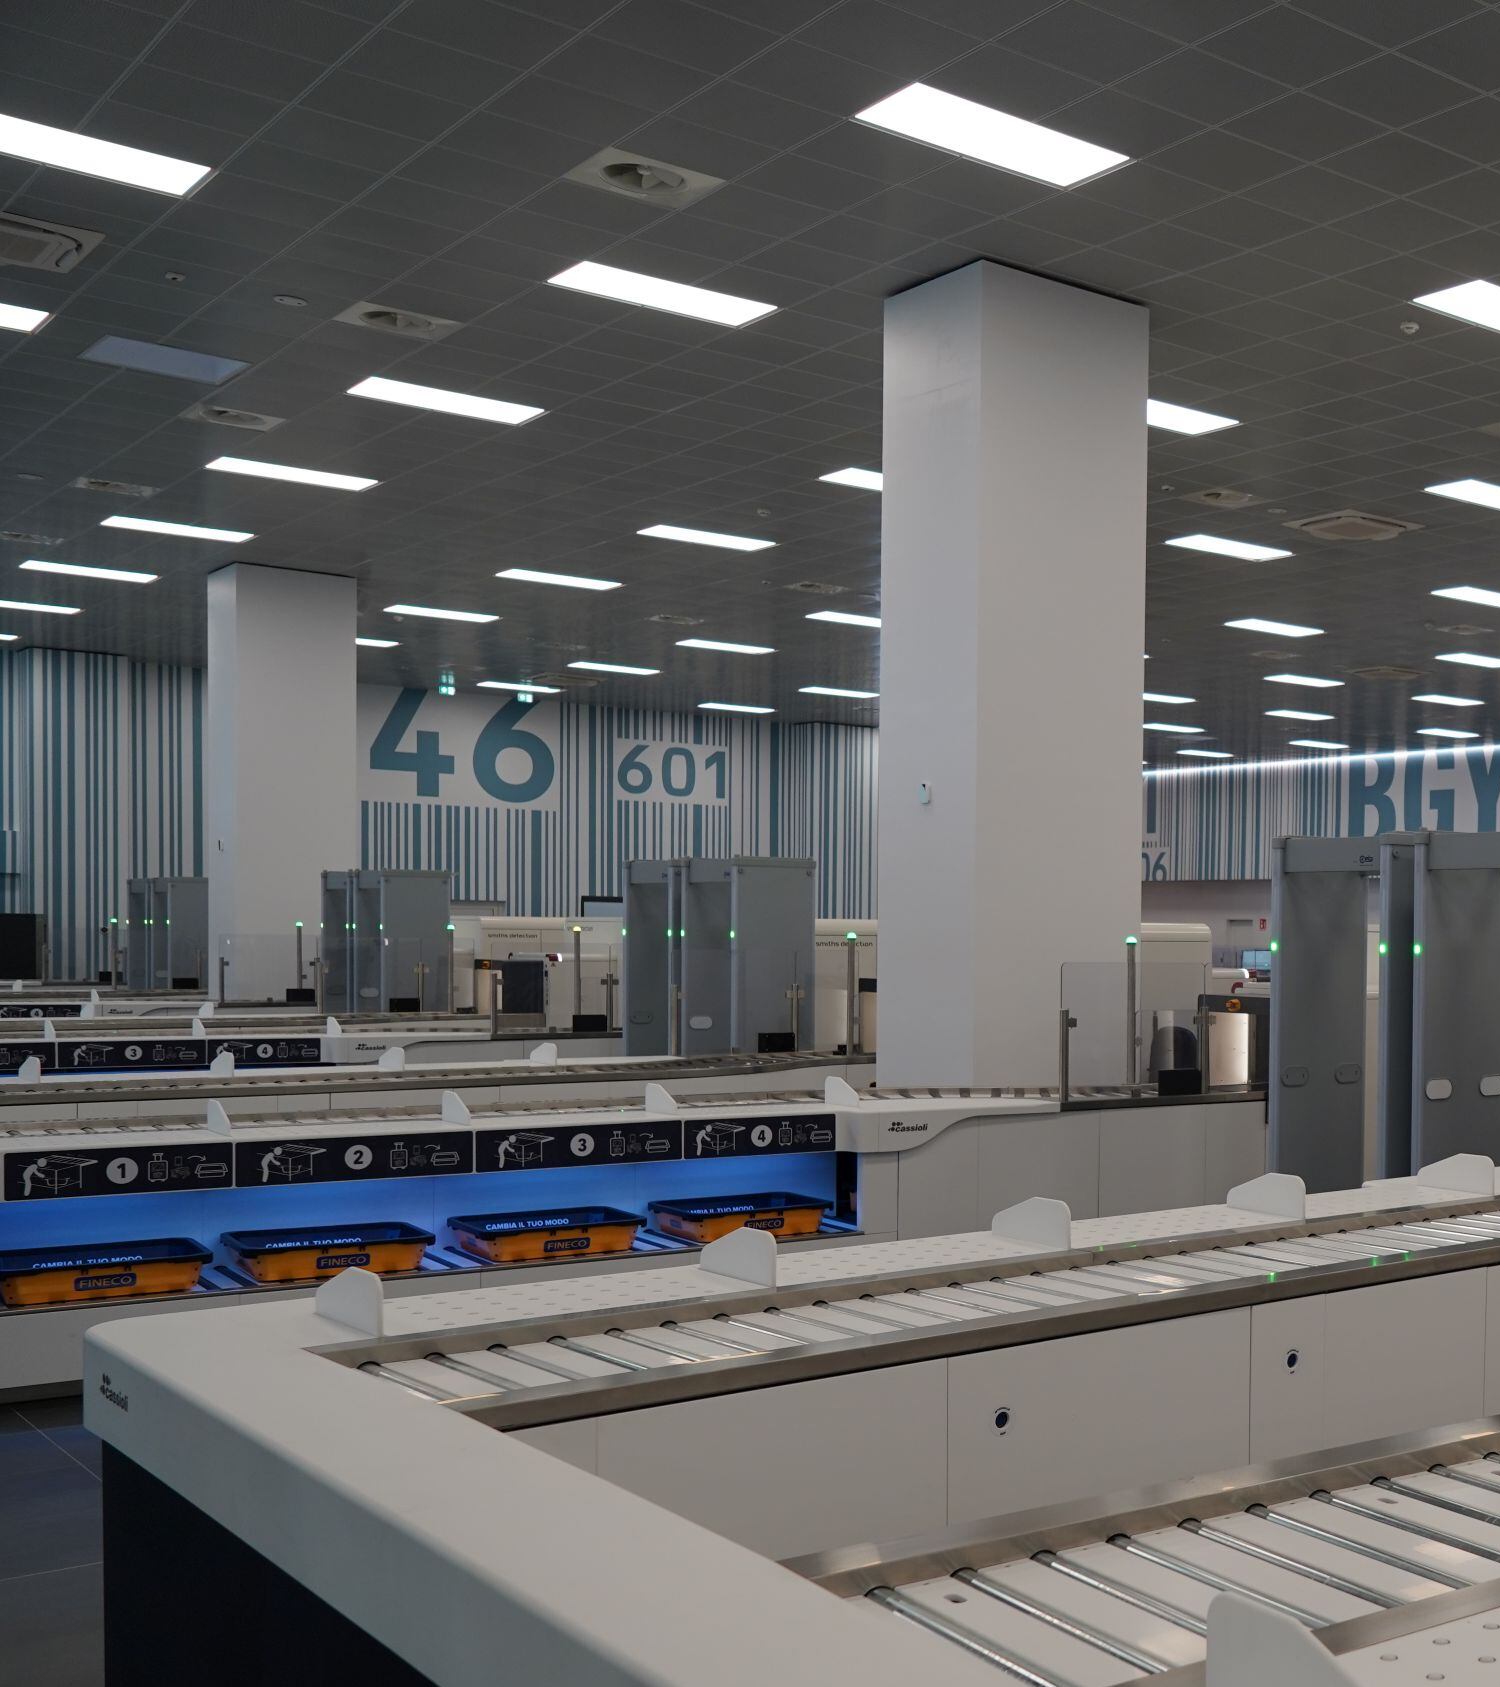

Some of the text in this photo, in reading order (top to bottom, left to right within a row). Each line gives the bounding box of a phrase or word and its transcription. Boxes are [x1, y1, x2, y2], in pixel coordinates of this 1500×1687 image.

[370, 687, 555, 803] 46
[617, 744, 726, 799] 601
[130, 1049, 137, 1058] 3
[260, 1047, 269, 1056] 4
[757, 1129, 766, 1142] 4
[577, 1138, 588, 1152] 3
[353, 1150, 364, 1165] 2
[116, 1163, 126, 1179] 1
[485, 1217, 570, 1231] CAMBIA IL TUO MODO
[747, 1219, 783, 1230] FINECO
[547, 1238, 587, 1251] FINECO
[320, 1255, 367, 1267] FINECO
[79, 1275, 133, 1289] FINECO
